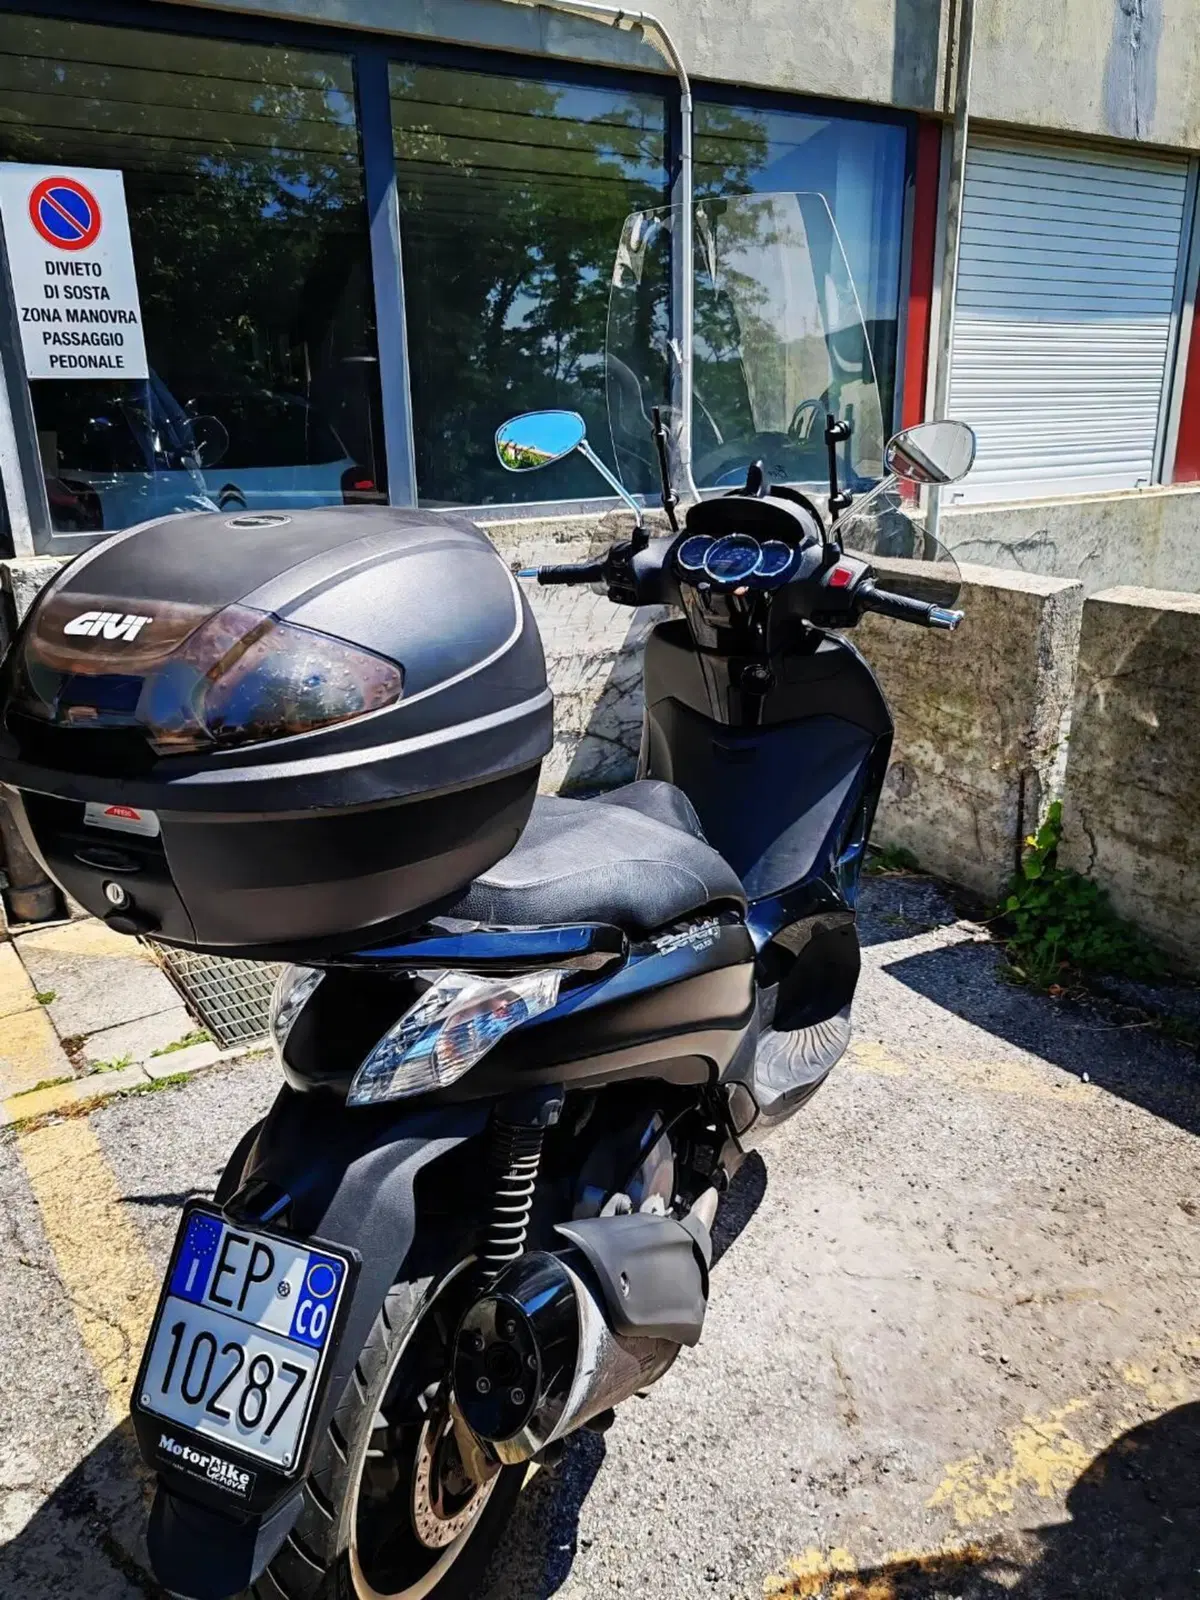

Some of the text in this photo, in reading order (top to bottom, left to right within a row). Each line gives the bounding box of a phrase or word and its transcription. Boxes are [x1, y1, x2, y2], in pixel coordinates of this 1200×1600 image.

[45, 260, 102, 277] DIVIETO
[43, 284, 110, 301] DI SOSTA
[22, 307, 138, 324] ZONA MANOVRA
[43, 331, 124, 347] PASSAGGIO
[49, 354, 125, 369] PEDONALE
[63, 611, 149, 642] GIVI
[208, 1231, 275, 1312] EP
[295, 1299, 328, 1339] CO
[161, 1321, 308, 1437] 10287
